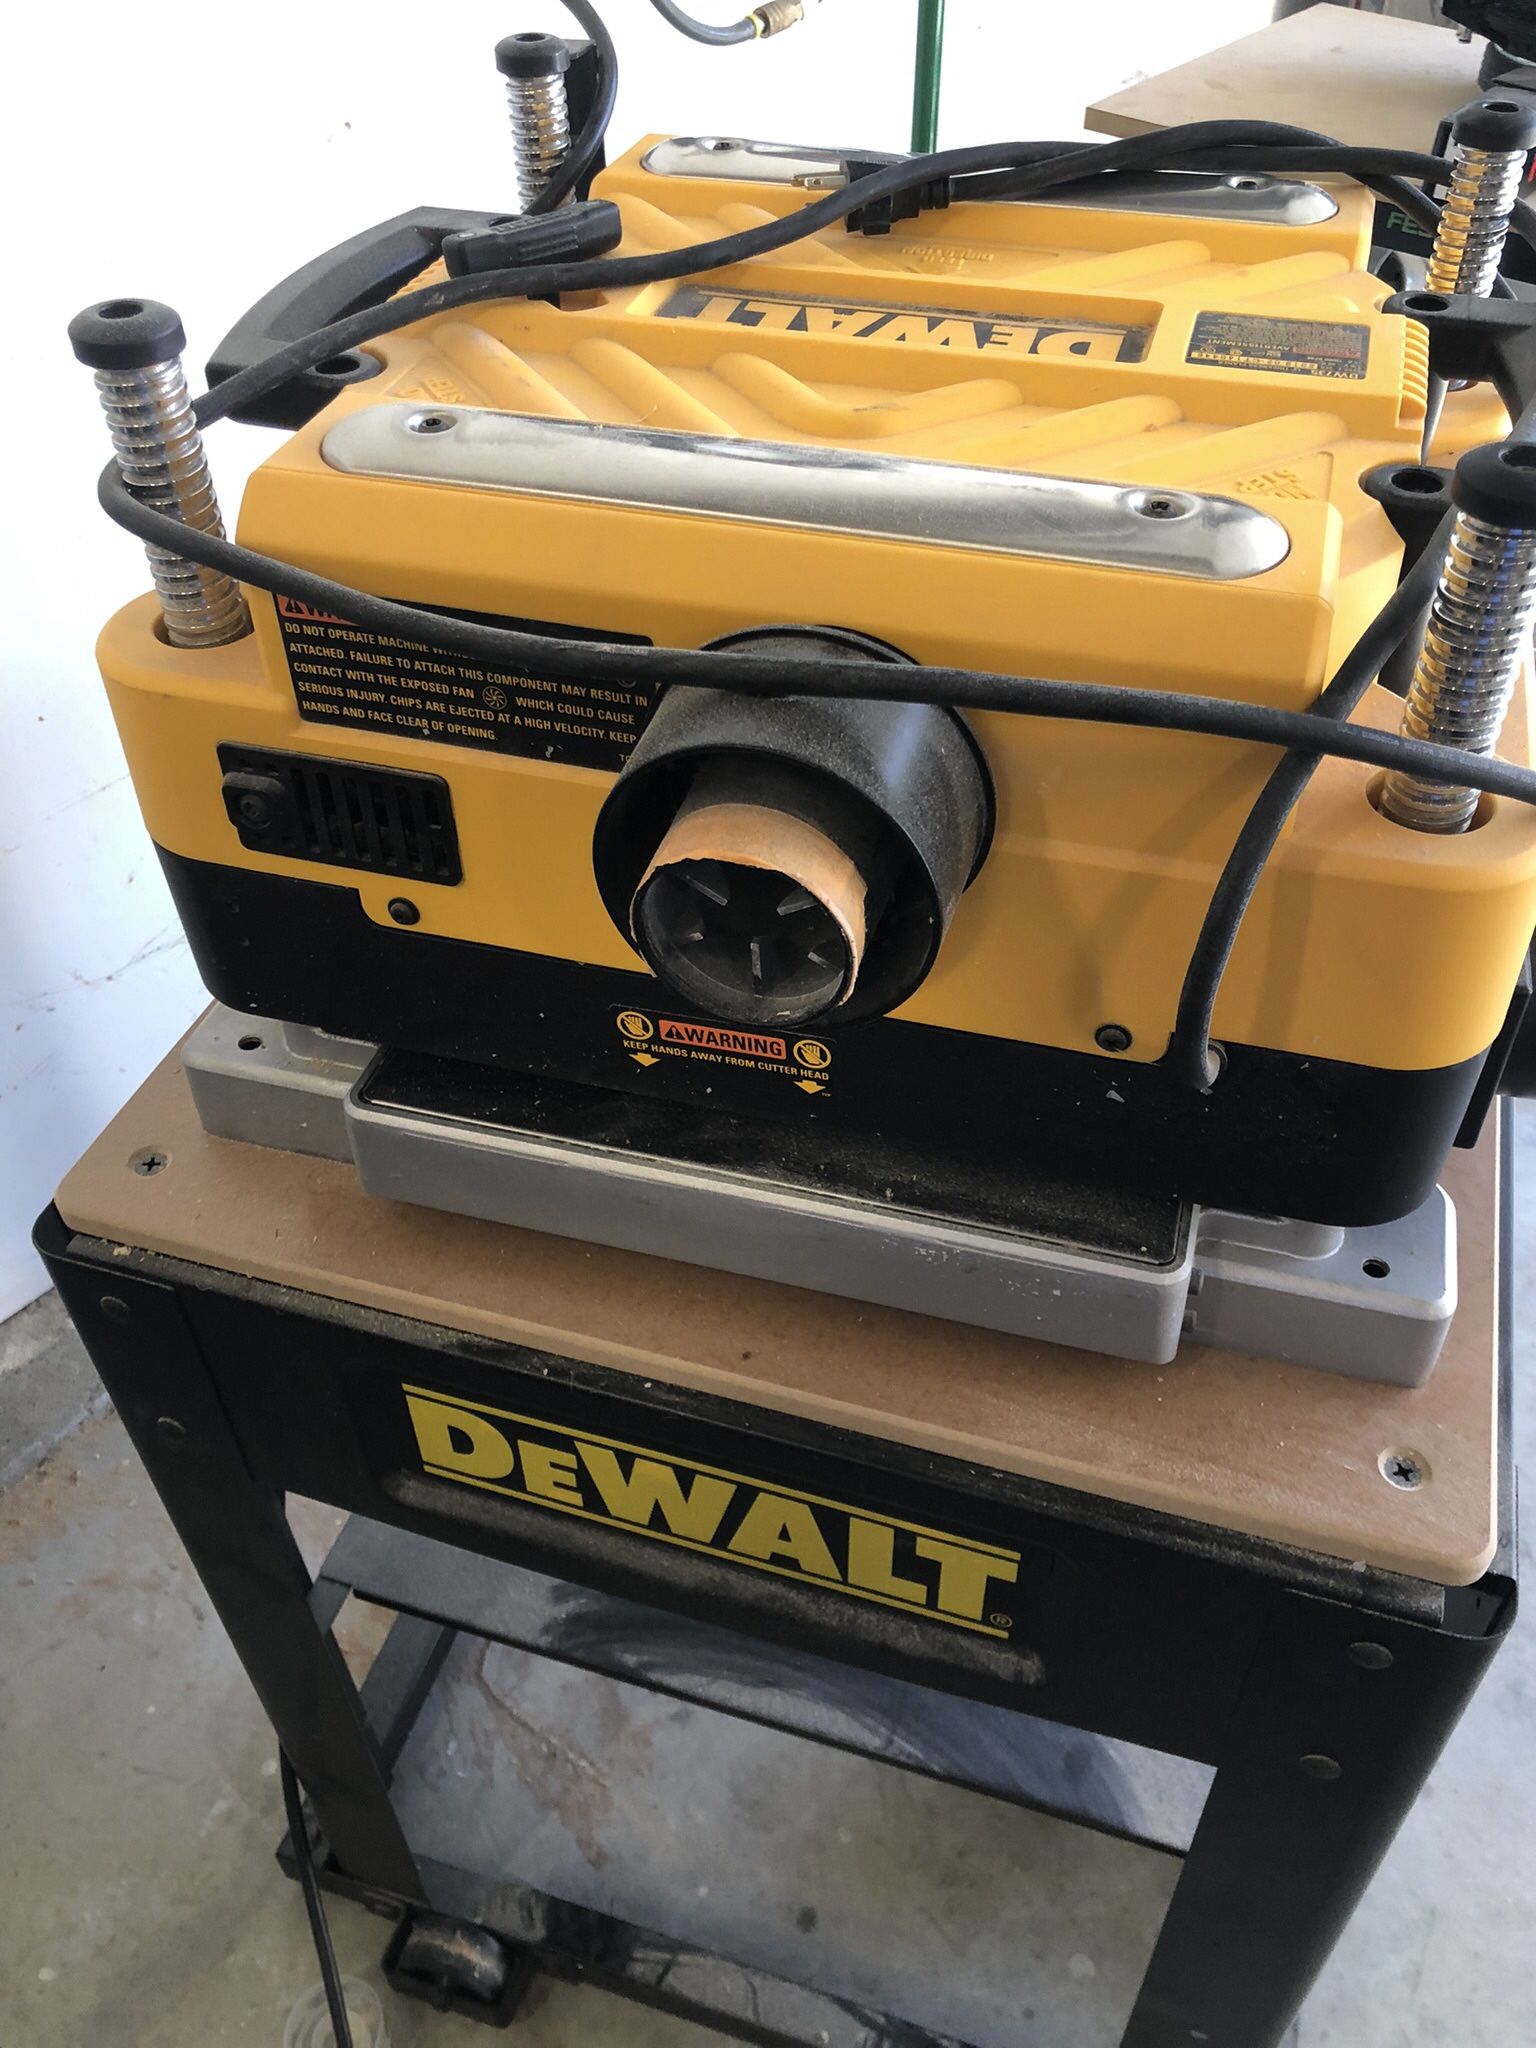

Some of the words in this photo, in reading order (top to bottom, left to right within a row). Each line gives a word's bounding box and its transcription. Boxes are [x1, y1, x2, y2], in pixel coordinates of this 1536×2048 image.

[284, 622, 300, 634] DO
[303, 624, 324, 637] NOT
[328, 627, 375, 645] OPERATE
[377, 635, 429, 653] MACHINE
[289, 642, 347, 660] ATTACHED.
[350, 650, 394, 667] FAILURE
[396, 657, 411, 669] TO
[414, 660, 456, 676] ATTACH
[459, 667, 484, 681] THIS
[486, 672, 557, 693] COMPONENT
[561, 684, 586, 697] MAY
[590, 689, 631, 704] RESULT
[635, 696, 648, 707] IN
[294, 662, 342, 678] CONTACT
[345, 669, 375, 683] WITH
[376, 673, 398, 687] THE
[400, 677, 449, 695] EXPOSED
[452, 686, 475, 699] FAN
[515, 696, 554, 712] WHICH
[557, 703, 594, 718] COULD
[597, 710, 635, 725] CAUSE
[298, 681, 344, 697] SERIOUS
[346, 688, 388, 704] INJURY.
[390, 695, 423, 709] CHIPS
[425, 700, 447, 713] ARE
[449, 704, 494, 721] EJECTED
[498, 713, 510, 724] AT
[513, 715, 522, 726] A
[524, 716, 551, 730] HIGH
[554, 722, 607, 740] VELOCITY.
[609, 731, 637, 744] KEEP
[302, 700, 340, 715] HANDS
[342, 706, 365, 719] AND
[368, 711, 393, 723] FACE
[396, 715, 429, 730] CLEAR
[431, 720, 444, 731] OF
[447, 724, 499, 741] OPENING.
[623, 1039, 649, 1051] KEEP
[651, 1044, 688, 1058] HANDS
[690, 1050, 723, 1064] AWAY
[725, 1055, 755, 1068] FROM
[757, 1061, 798, 1076] CUTTER
[800, 1068, 829, 1081] HEAD
[684, 1027, 782, 1057] WARNING
[405, 1394, 1018, 1621] DEWALT
